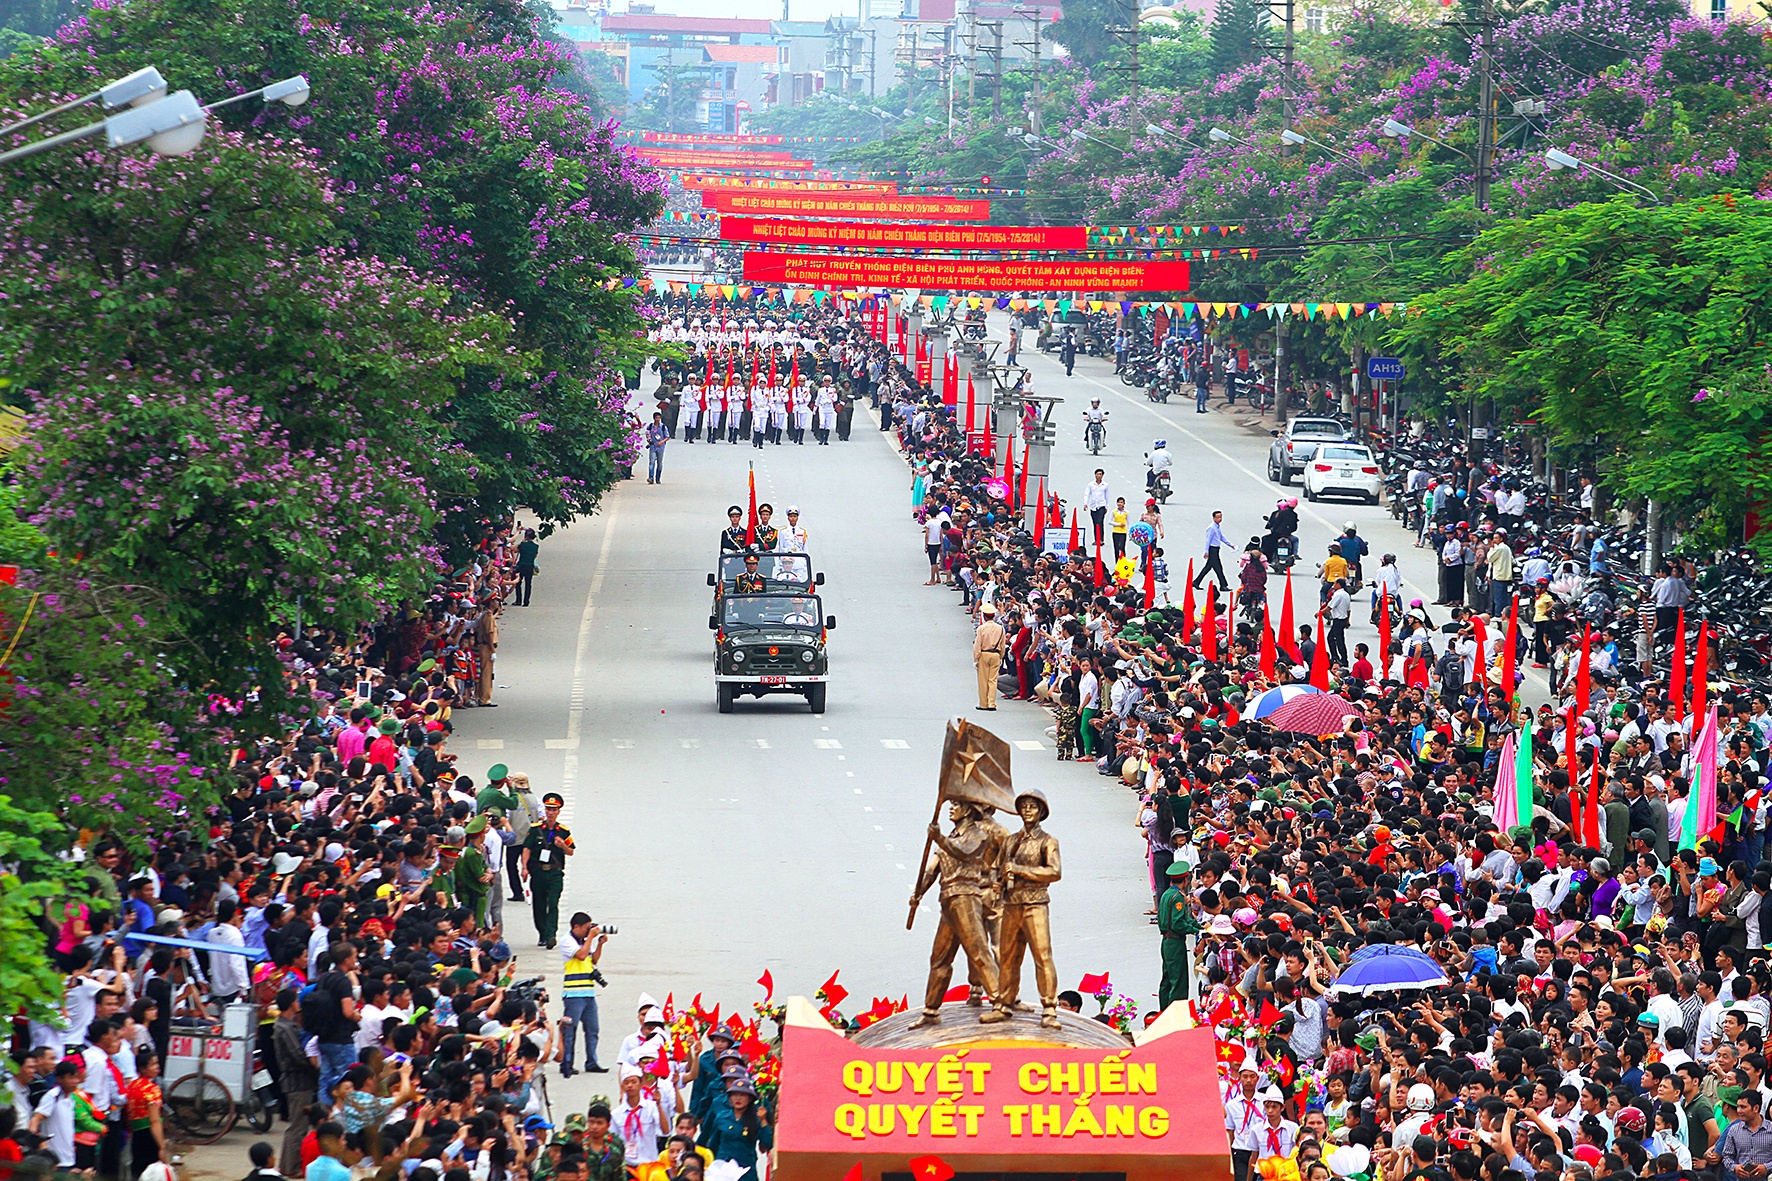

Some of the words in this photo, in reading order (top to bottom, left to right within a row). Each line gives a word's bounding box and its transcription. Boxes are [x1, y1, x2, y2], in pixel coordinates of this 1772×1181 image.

[754, 224, 772, 236] NHIỆT
[774, 225, 787, 236] LIỆT
[788, 226, 806, 237] CHÀO
[808, 226, 827, 238] MỪNG
[839, 227, 856, 240] NIỆM
[857, 231, 865, 239] 60
[868, 229, 882, 240] NĂM
[884, 228, 904, 241] CHIẾN
[905, 229, 926, 242] THẮNG
[928, 229, 943, 243] ĐIỆN
[945, 230, 960, 242] BIÊN
[962, 229, 974, 242] PHỦ
[786, 258, 808, 268] PHÁT
[830, 259, 861, 270] TRUYỀN
[864, 260, 890, 271] THỐNG
[894, 262, 913, 273] ĐIỆN
[916, 262, 934, 272] BIÊN
[938, 262, 954, 273] PHỦ
[957, 265, 974, 273] ANH
[1006, 264, 1032, 275] QUYẾT
[1034, 265, 1051, 275] TÂM
[1054, 265, 1071, 275] XÂY
[1074, 266, 1097, 276] DỰNG
[1100, 266, 1120, 277] ĐIỆN
[1122, 266, 1144, 275] BIÊN:
[800, 270, 820, 281] ĐỊNH
[822, 270, 849, 281] CHÍNH
[868, 274, 889, 283] KINH
[890, 272, 901, 283] TẾ
[906, 274, 918, 284] XÃ
[920, 274, 934, 285] HỘI
[937, 274, 958, 284] PHÁT
[990, 276, 1012, 287] QUỐC
[1015, 276, 1044, 287] PHÒNG
[1050, 278, 1061, 287] AN
[1064, 278, 1084, 287] NINH
[1087, 276, 1110, 287] VỮNG
[1112, 278, 1138, 289] MẠNH
[1372, 364, 1401, 373] AH13
[168, 1036, 192, 1057] EM
[842, 1048, 991, 1096] QUYẾT
[1017, 1050, 1158, 1095] CHIẾN
[834, 1092, 986, 1138] QUYẾT
[1002, 1092, 1170, 1137] THẮNG
